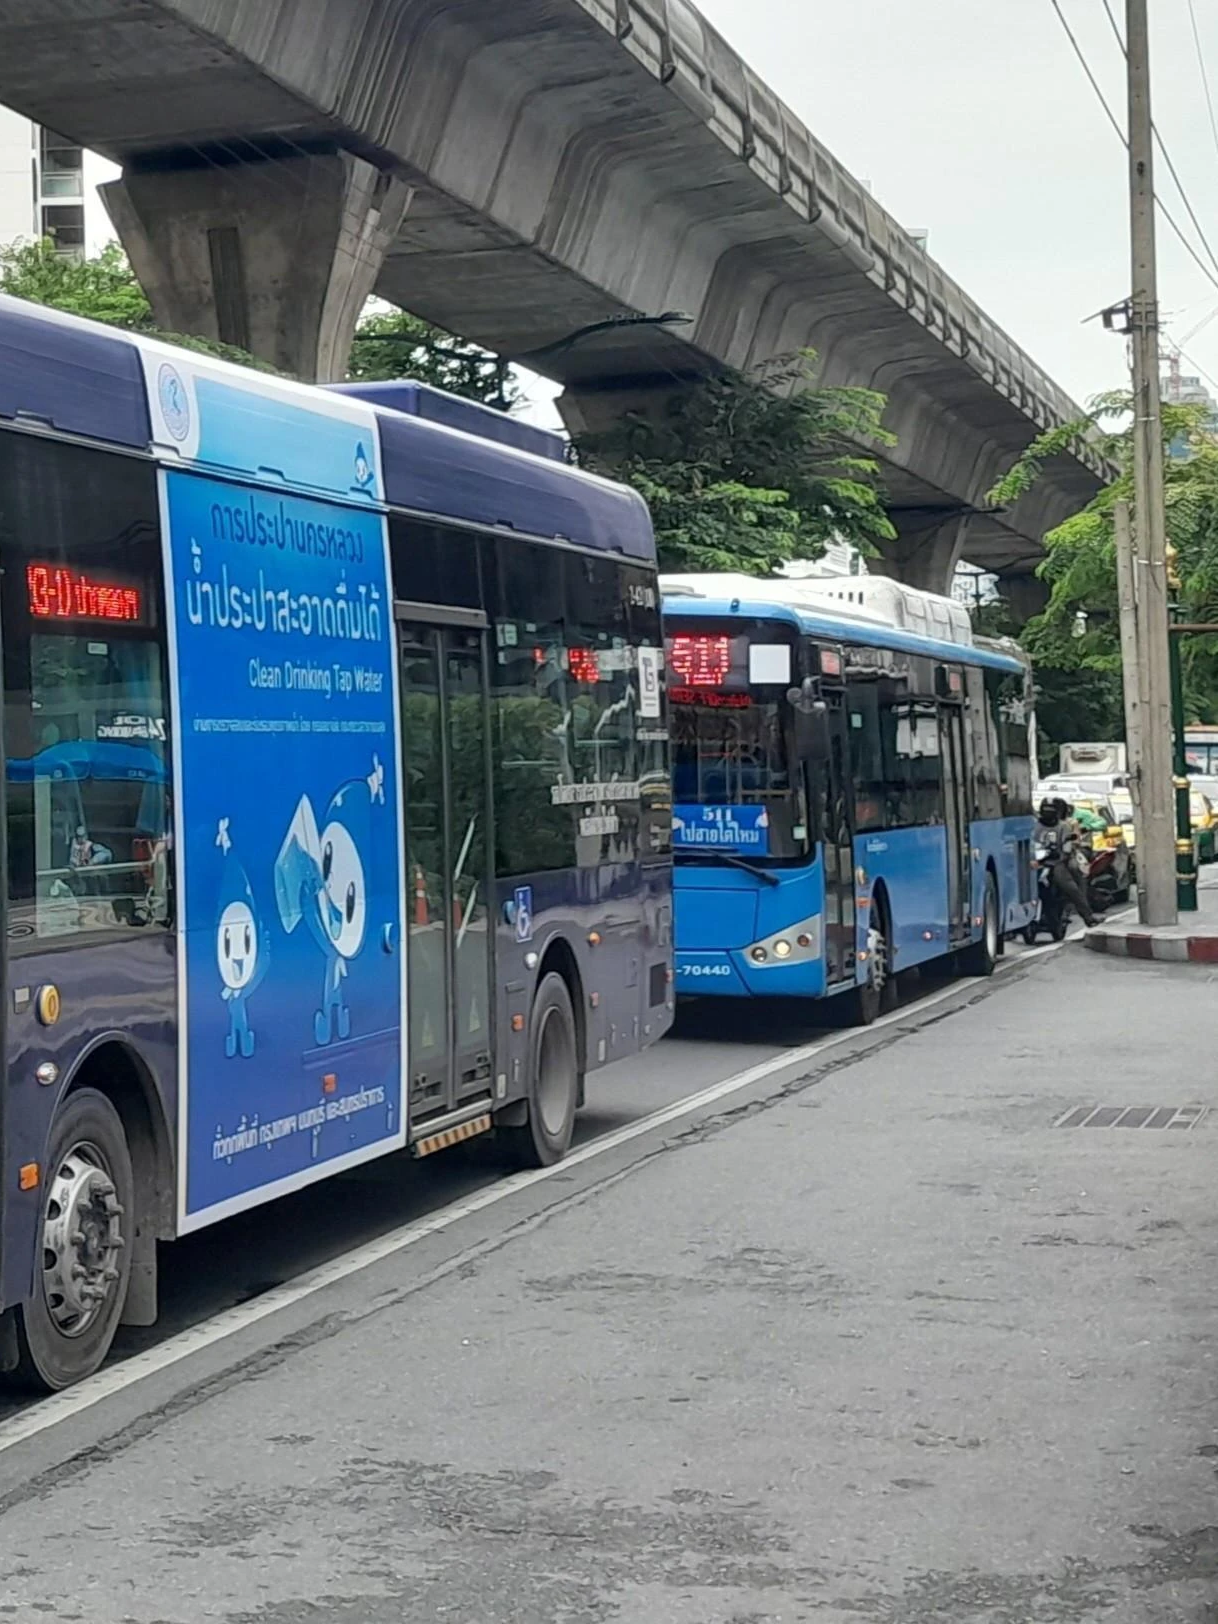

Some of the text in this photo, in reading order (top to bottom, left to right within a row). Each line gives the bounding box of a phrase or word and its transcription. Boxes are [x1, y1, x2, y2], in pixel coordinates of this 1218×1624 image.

[210, 495, 364, 564] การประปานครหลวง
[186, 537, 382, 642] น้ำประปาสะอาดดื่มได้
[249, 657, 383, 699] Clean Drinking Tap Water
[702, 808, 732, 822] 511
